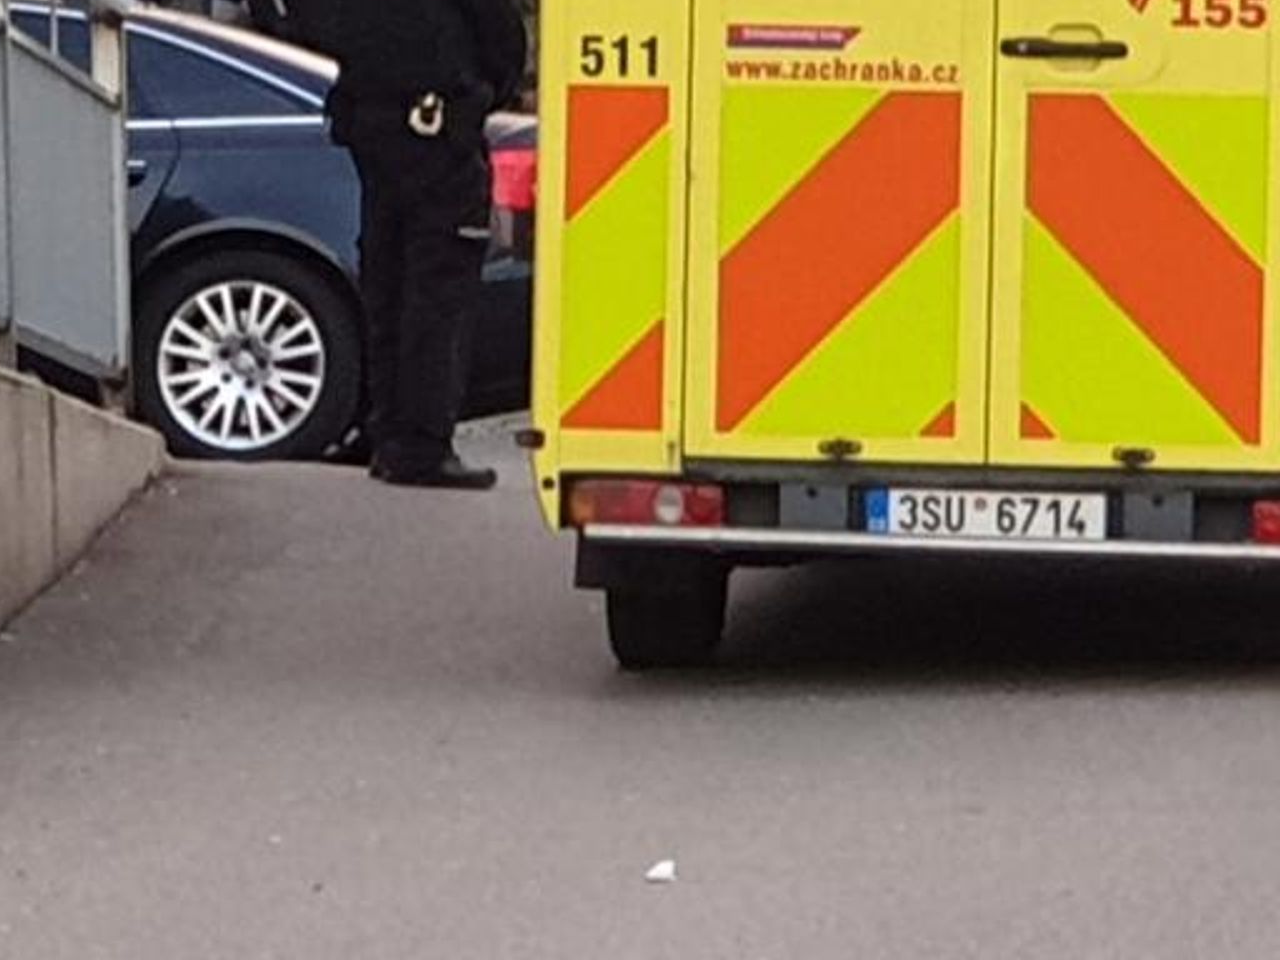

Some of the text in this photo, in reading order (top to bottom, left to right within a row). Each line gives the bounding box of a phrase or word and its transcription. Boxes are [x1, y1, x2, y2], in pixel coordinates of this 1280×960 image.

[581, 34, 658, 77] 511
[726, 57, 959, 83] www.zachranka.cz
[898, 494, 1086, 536] 3SU 6714
